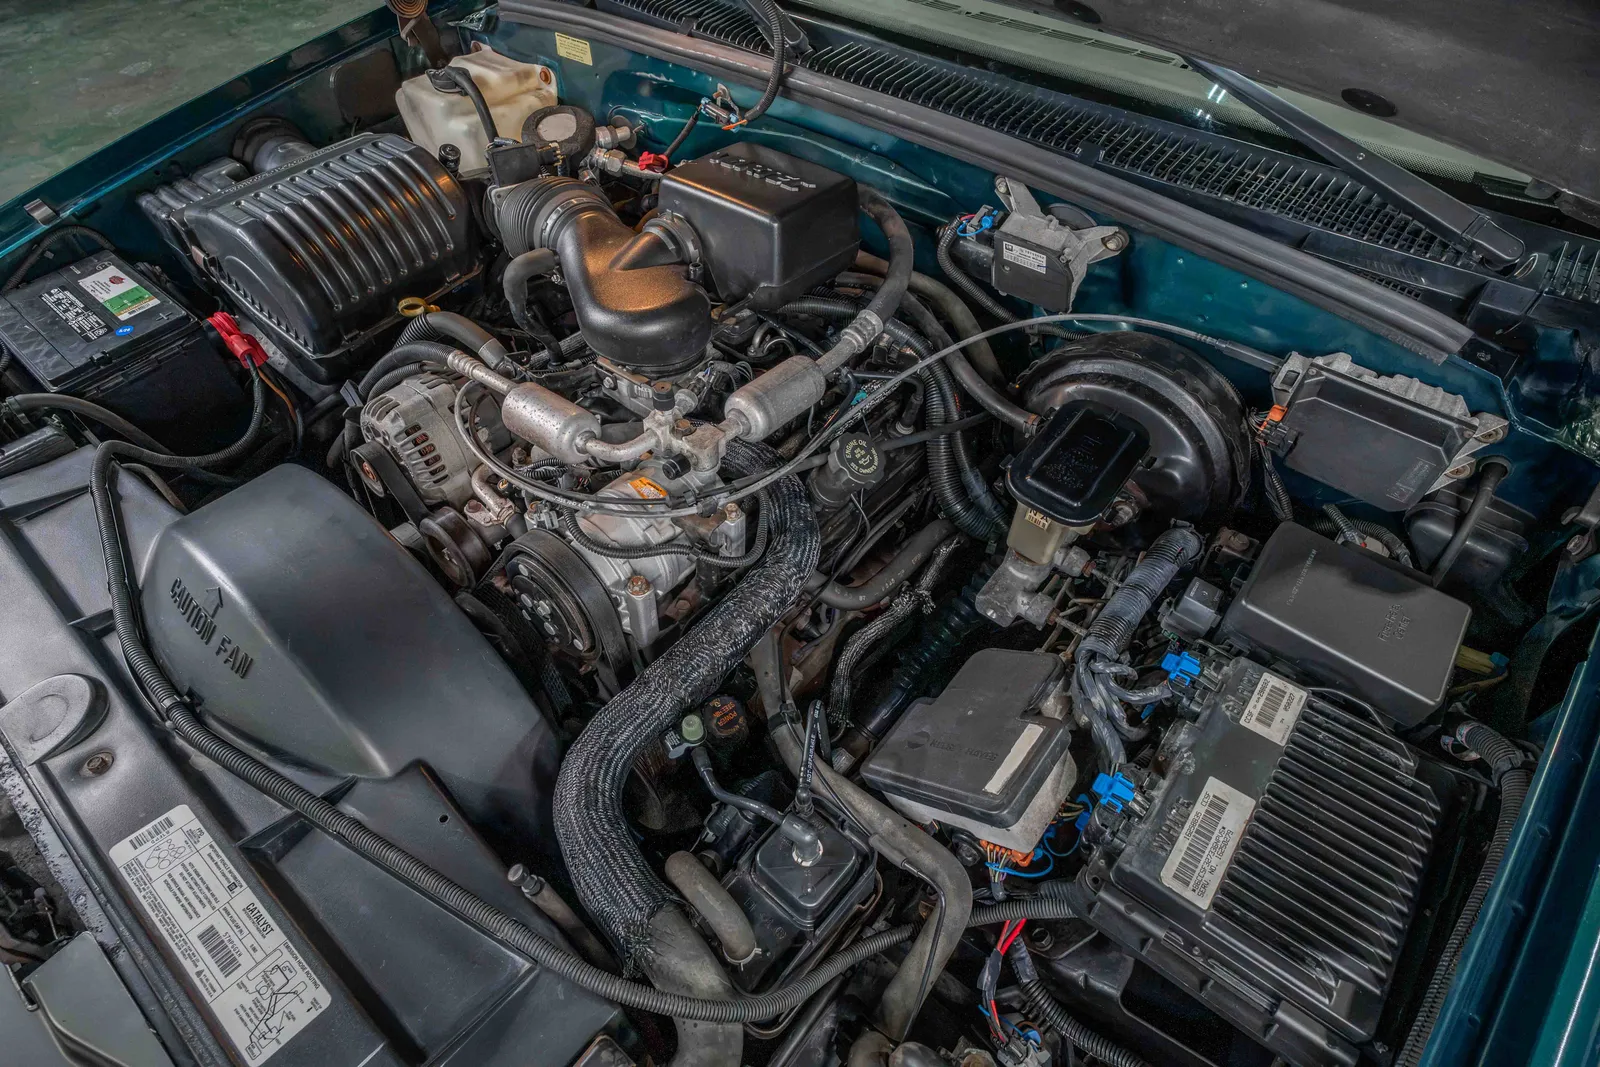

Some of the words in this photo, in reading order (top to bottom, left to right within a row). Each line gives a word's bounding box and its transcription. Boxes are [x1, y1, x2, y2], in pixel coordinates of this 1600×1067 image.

[844, 439, 857, 458] ENGINE
[858, 439, 867, 447] OIL
[169, 576, 216, 645] CAUTION
[215, 634, 253, 679] FAN
[1200, 791, 1212, 807] CCSF
[1196, 877, 1211, 898] SERV.
[1208, 862, 1218, 875] NO.
[244, 901, 274, 936] CATALYST
[282, 941, 299, 961] EMISSION
[296, 959, 307, 972] HOSE
[304, 970, 320, 989] ROUTING
